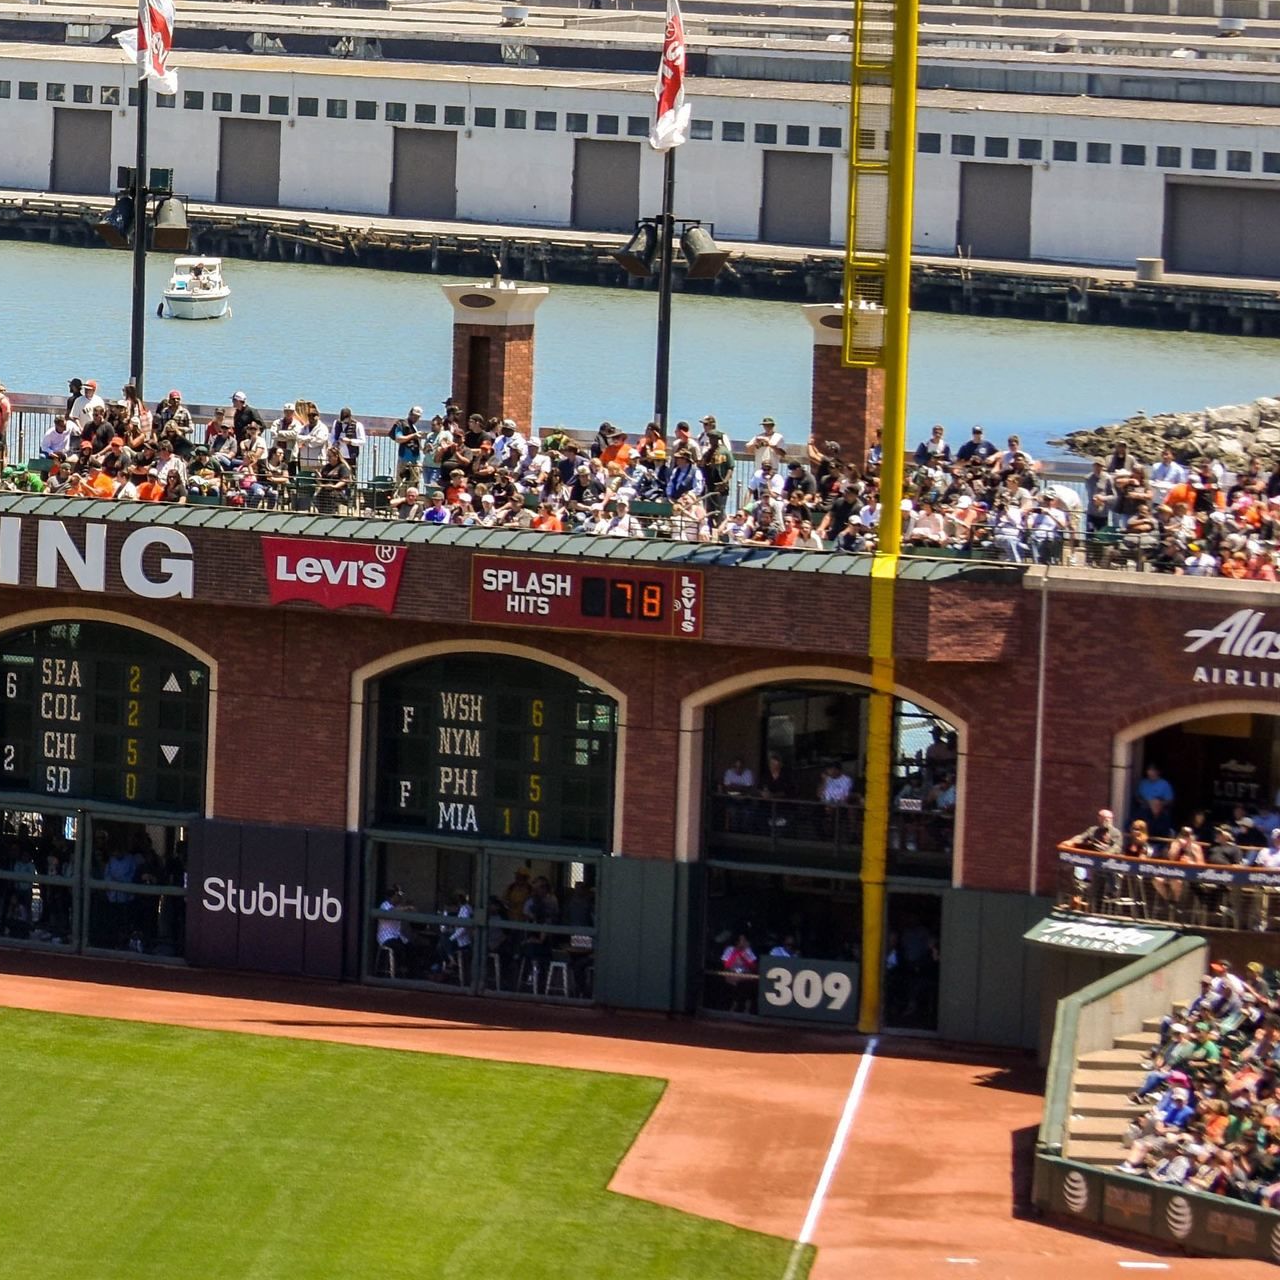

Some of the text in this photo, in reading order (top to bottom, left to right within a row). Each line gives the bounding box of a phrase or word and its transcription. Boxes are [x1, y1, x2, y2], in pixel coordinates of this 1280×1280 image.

[482, 569, 571, 596] SPLASH
[506, 594, 550, 615] HITS
[616, 583, 662, 617] 78
[6, 672, 18, 699] 6
[42, 657, 141, 693] SEA 2
[41, 692, 139, 726] COL 2
[402, 706, 414, 734] F
[440, 692, 543, 727] WSH 6
[3, 745, 15, 772] 2
[43, 731, 138, 766] CHI 5
[439, 728, 541, 762] NYM 1
[46, 766, 136, 800] SD 0
[399, 780, 411, 808] F
[438, 766, 540, 802] PHI 5
[438, 802, 479, 833] MIA
[202, 877, 342, 923] StubHub
[765, 966, 852, 1010] 309
